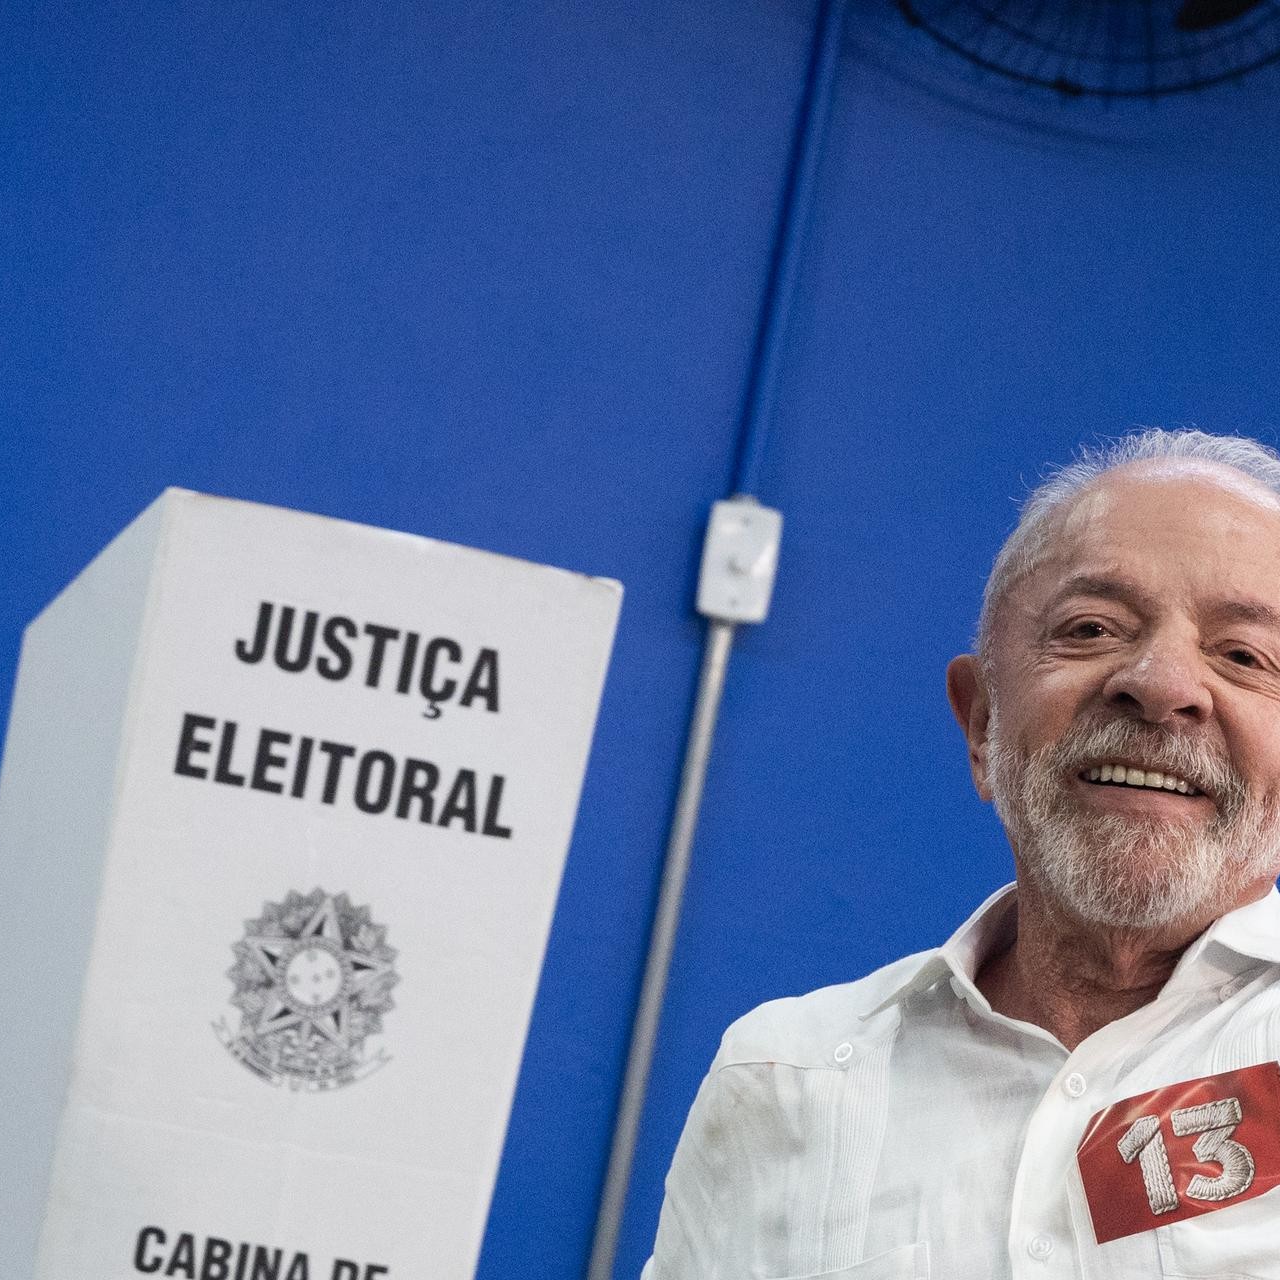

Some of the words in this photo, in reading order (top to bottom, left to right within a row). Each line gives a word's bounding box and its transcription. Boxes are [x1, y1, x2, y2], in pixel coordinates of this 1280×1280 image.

[234, 600, 500, 721] JUSTIÇA
[173, 711, 513, 840] ELEITORAL
[1116, 1096, 1256, 1216] 13
